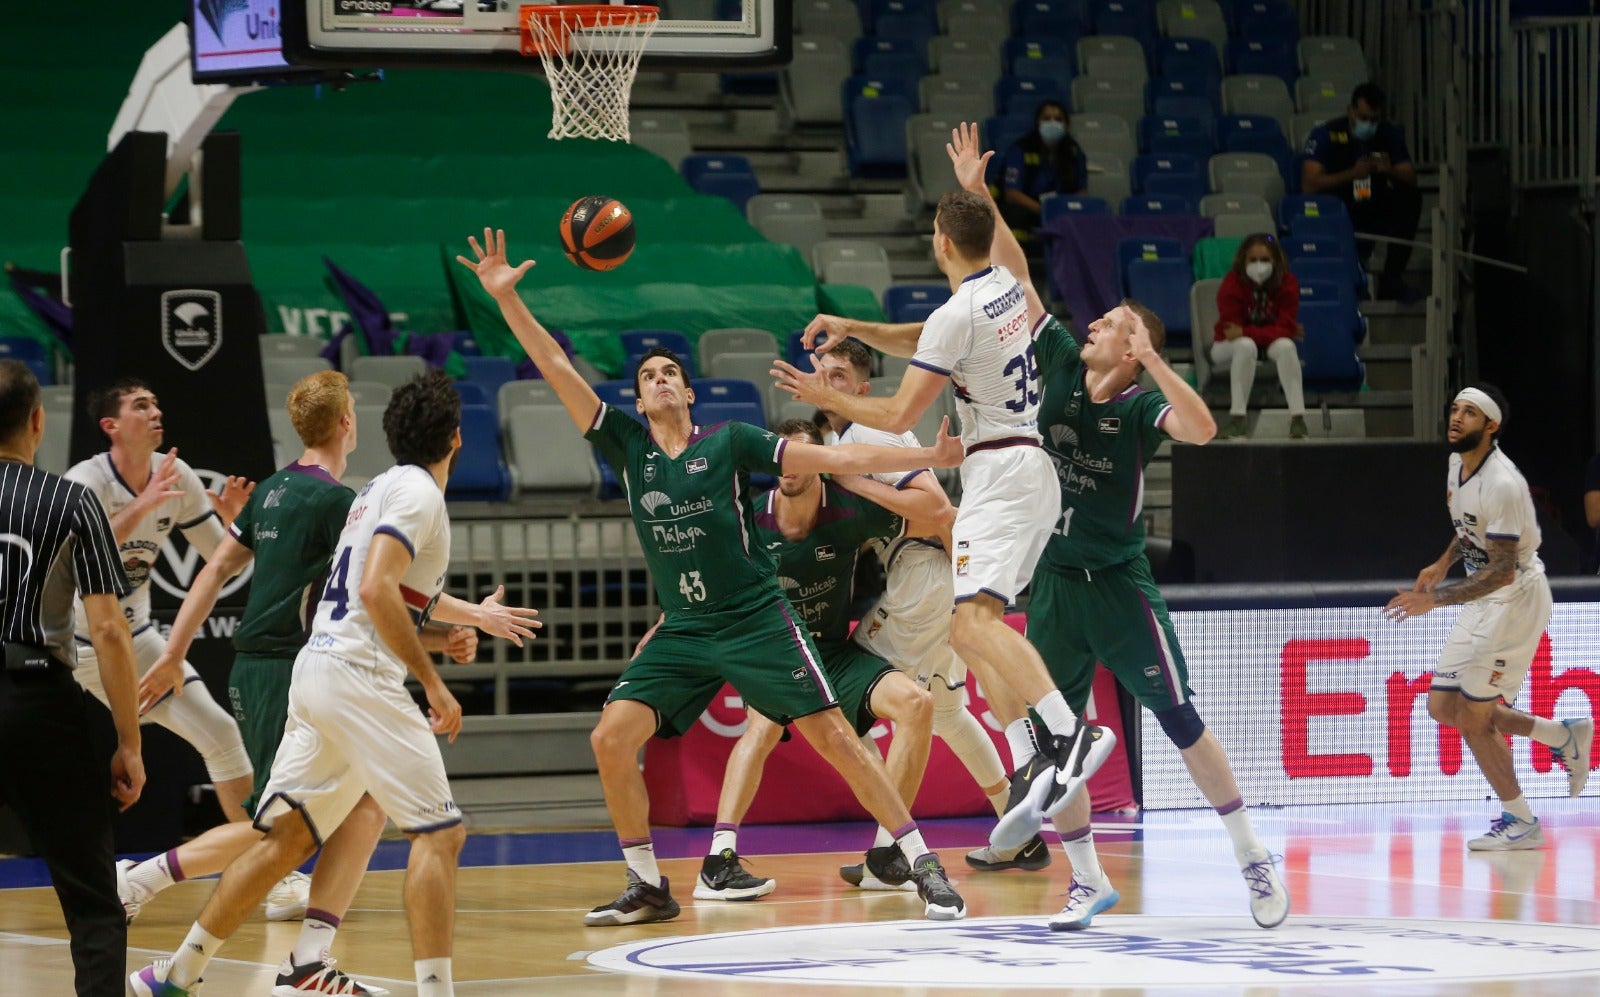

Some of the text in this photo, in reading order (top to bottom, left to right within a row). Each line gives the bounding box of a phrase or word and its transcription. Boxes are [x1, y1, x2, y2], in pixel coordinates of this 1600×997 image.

[341, 0, 391, 12] endesa
[1003, 342, 1040, 413] 39
[1073, 448, 1113, 472] Unicaja
[670, 496, 714, 516] Unicaja
[652, 524, 707, 545] Málaga
[322, 546, 352, 621] 4
[679, 570, 707, 603] 43
[799, 575, 837, 597] Unicaja
